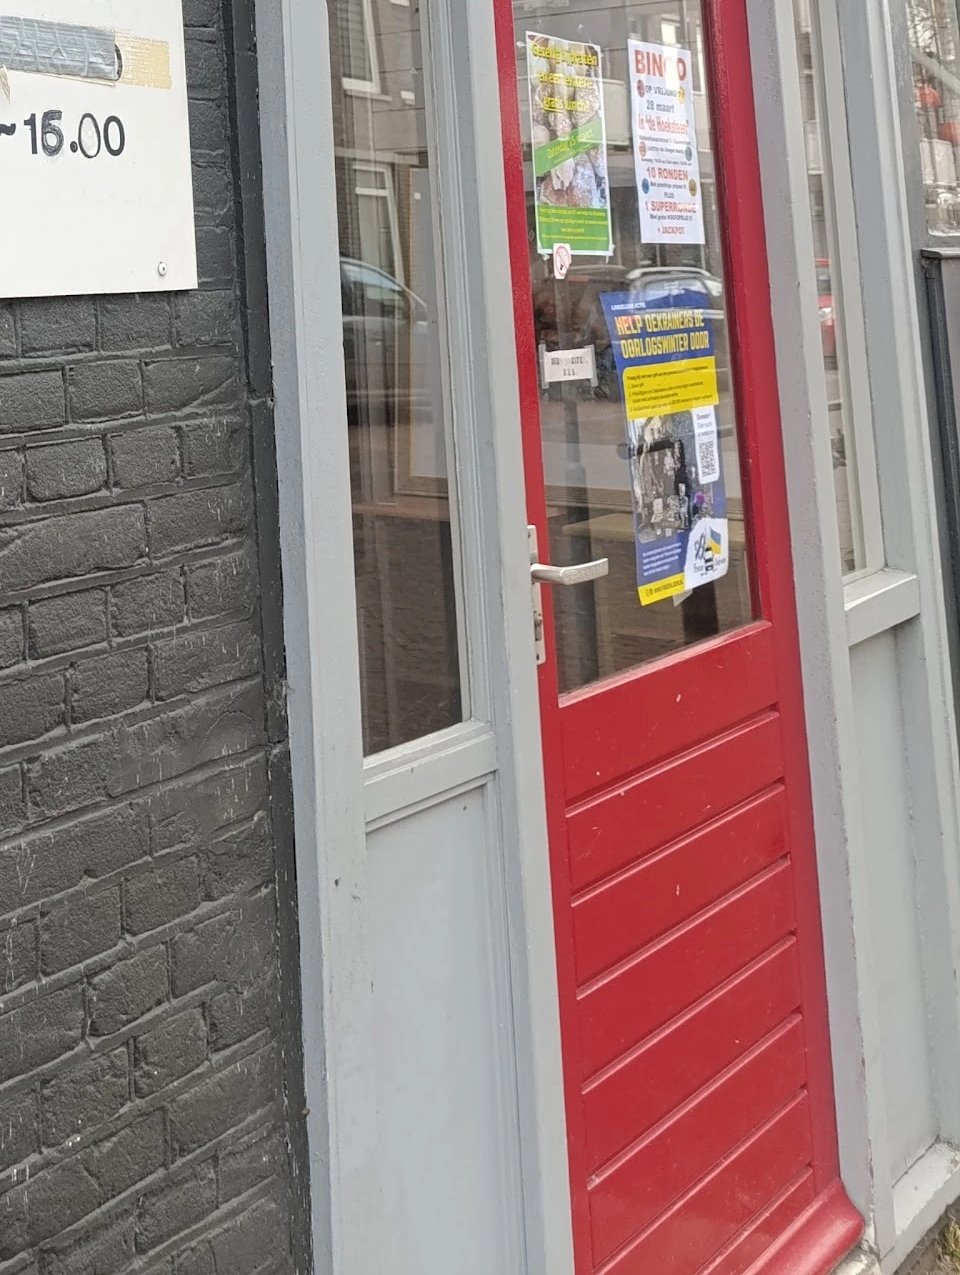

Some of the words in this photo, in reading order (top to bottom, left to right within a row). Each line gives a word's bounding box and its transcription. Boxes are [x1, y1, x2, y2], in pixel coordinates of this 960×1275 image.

[646, 99, 655, 111] 28
[655, 103, 675, 114] maart
[647, 166, 656, 179] 10
[658, 168, 689, 181] RONDEN
[661, 226, 686, 235] JACKPOT
[614, 314, 643, 335] HELP
[620, 332, 690, 359] OORLOGSWINTER
[690, 330, 710, 351] DOOR
